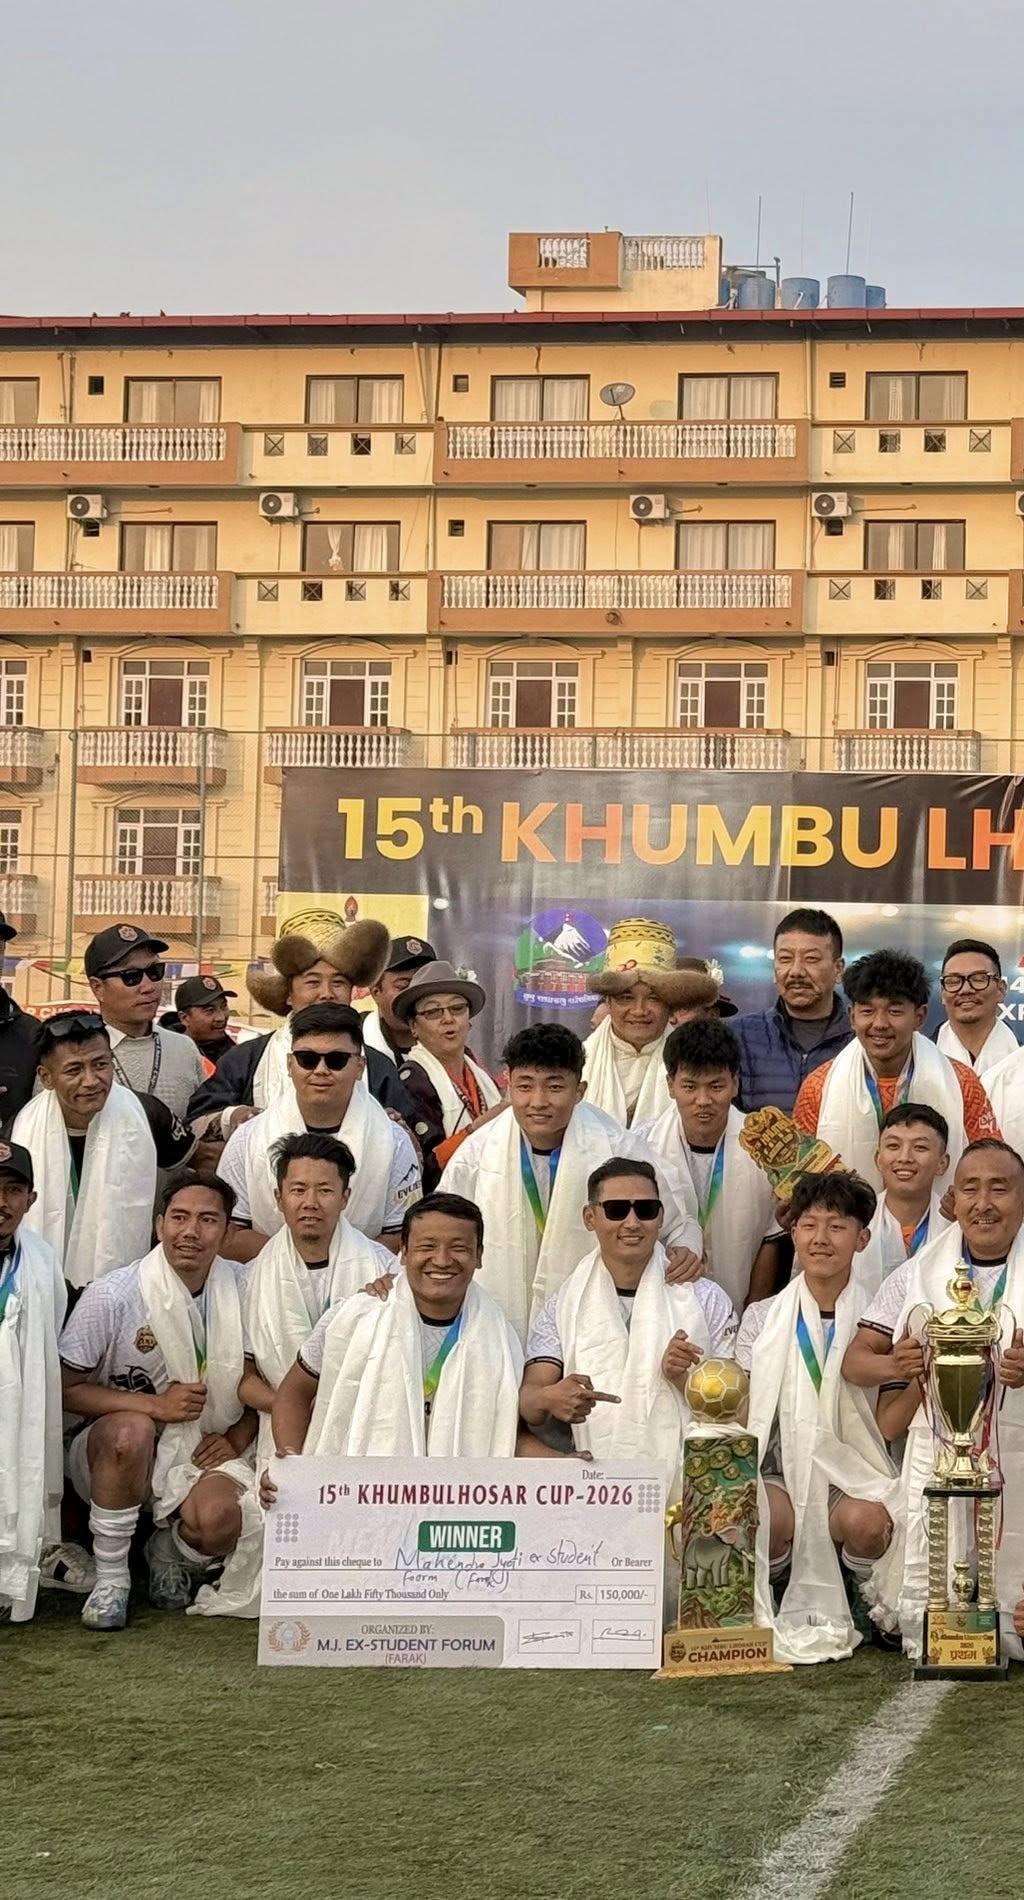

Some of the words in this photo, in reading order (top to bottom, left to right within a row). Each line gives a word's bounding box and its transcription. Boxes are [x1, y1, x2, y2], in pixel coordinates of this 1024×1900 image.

[337, 795, 484, 863] 15th
[501, 800, 899, 870] KHUMBU
[582, 1469, 604, 1480] Date:
[319, 1483, 350, 1505] 15th
[357, 1484, 527, 1505] KHUMBULHOSAR
[536, 1485, 633, 1505] CUP-2026
[429, 1525, 503, 1549] WINNER
[275, 1556, 290, 1569] Pay
[292, 1557, 323, 1568] against
[324, 1556, 341, 1567] this
[341, 1556, 372, 1568] cheque
[373, 1557, 383, 1567] to
[611, 1557, 623, 1567] Or
[624, 1557, 653, 1567] Bearer
[273, 1588, 288, 1599] the
[288, 1591, 307, 1599] sum
[309, 1588, 320, 1599] of
[321, 1589, 339, 1599] One
[341, 1588, 362, 1599] Lakh
[364, 1588, 384, 1601] Fifty
[385, 1588, 427, 1599] Thousand
[428, 1589, 449, 1601] Only
[600, 1590, 649, 1601] 150,000/-
[361, 1624, 418, 1635] ORGANIZED
[419, 1625, 435, 1635] BY:
[316, 1639, 341, 1651] M.J.
[346, 1639, 437, 1651] EX-STUDENT
[441, 1639, 496, 1651] FORUM
[384, 1653, 427, 1665] (FARAK)
[688, 1648, 768, 1663] CHAMPION
